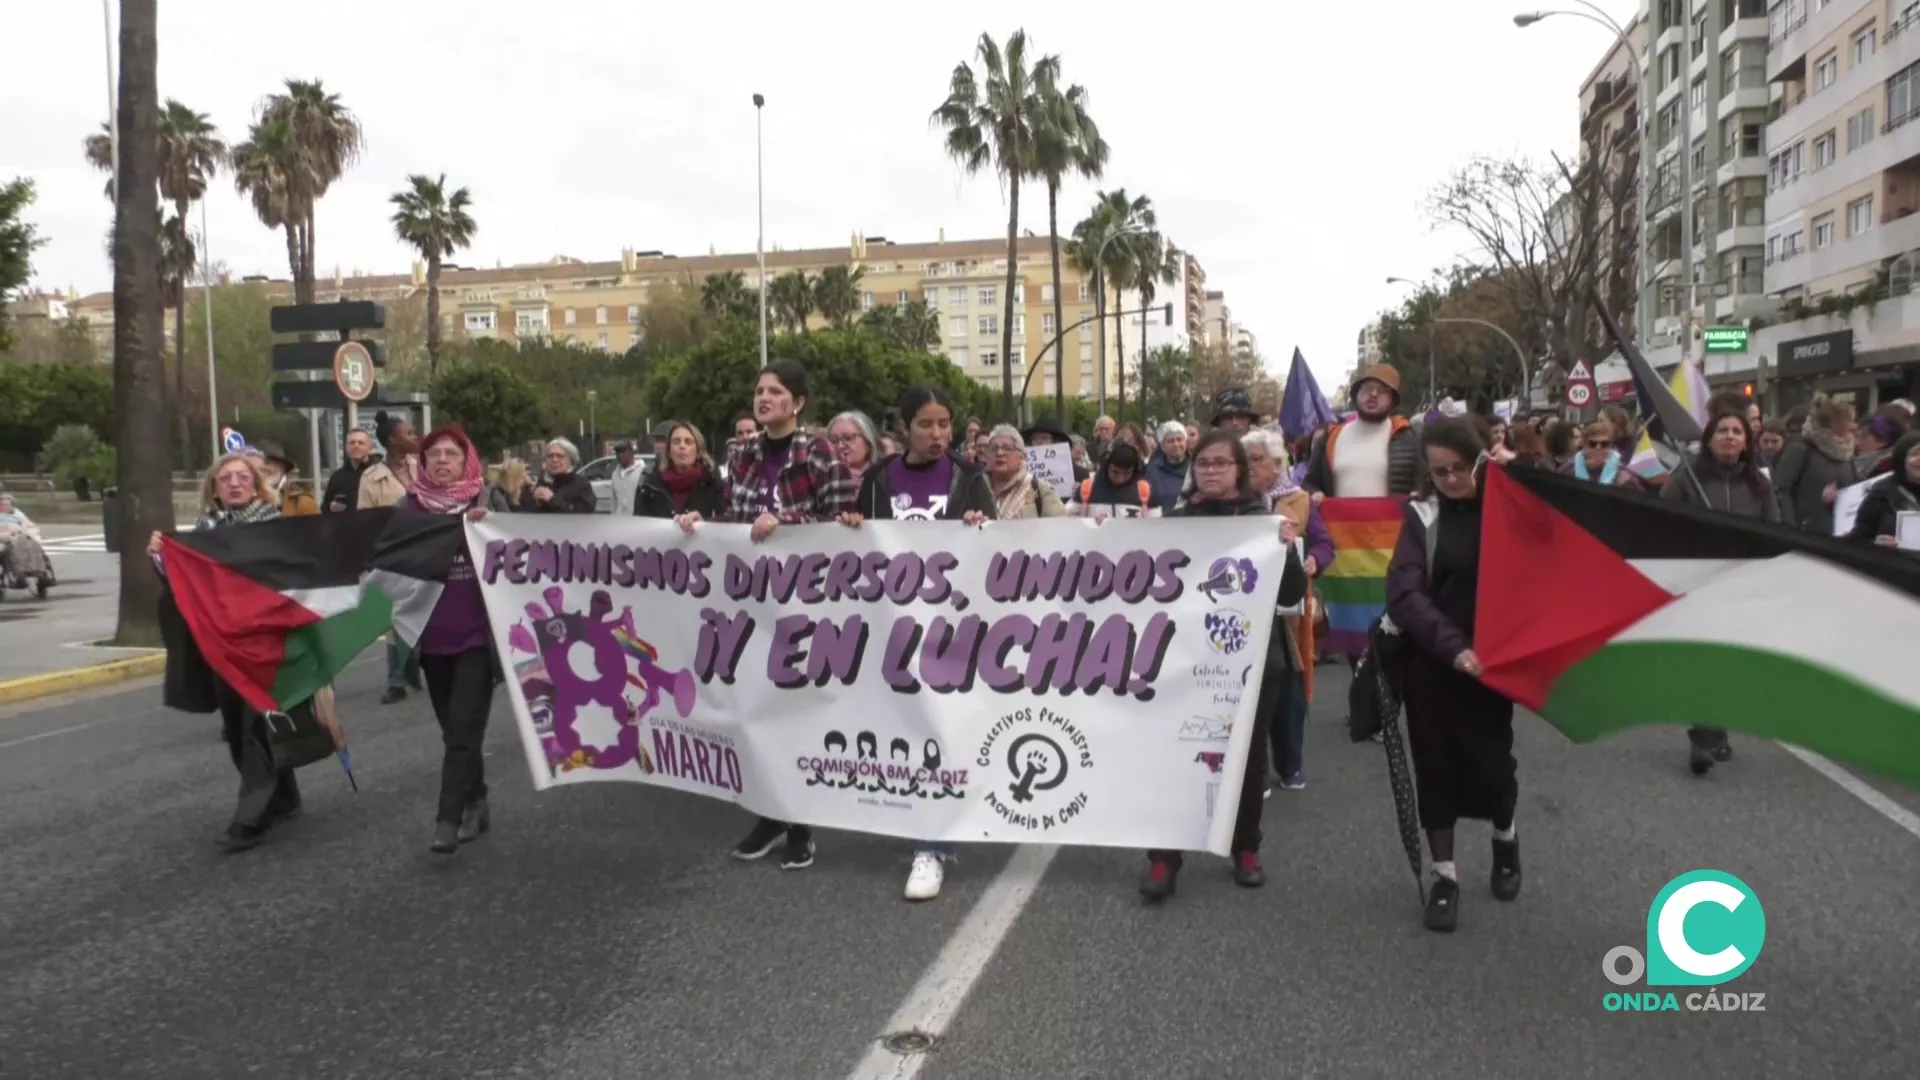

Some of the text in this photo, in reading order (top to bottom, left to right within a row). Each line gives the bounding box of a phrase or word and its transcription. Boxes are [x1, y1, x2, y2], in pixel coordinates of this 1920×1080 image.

[1704, 330, 1747, 341] FARMACIA
[1572, 389, 1587, 399] 50
[482, 538, 713, 599] FEMINISMOS
[723, 550, 970, 612] DIVERSOS,
[984, 549, 1191, 605] UNIDOS
[693, 607, 1177, 703] ¡Y EN LUCHA!
[651, 728, 743, 795] MARZO
[886, 764, 912, 781] 8M
